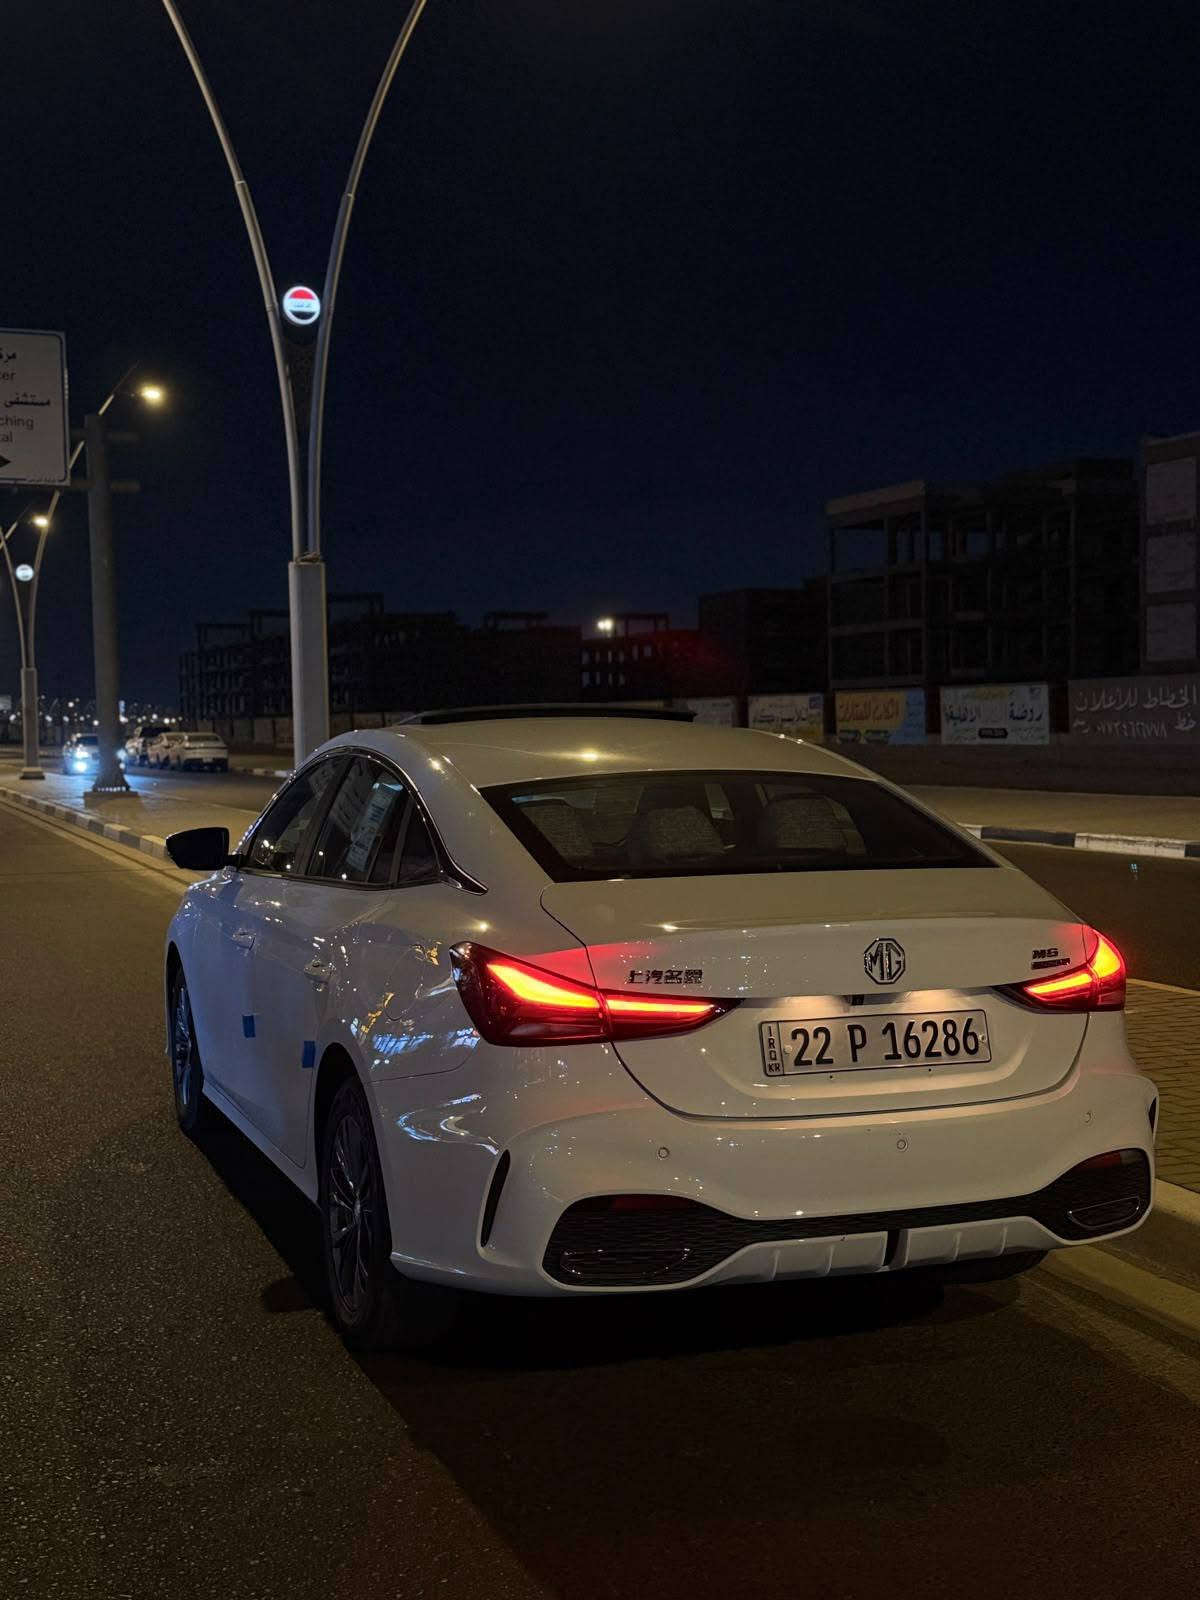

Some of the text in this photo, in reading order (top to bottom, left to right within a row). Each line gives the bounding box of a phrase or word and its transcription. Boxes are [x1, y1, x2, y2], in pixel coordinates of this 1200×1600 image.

[866, 940, 903, 982] MG
[791, 1017, 979, 1066] 22 P 16286
[768, 1062, 781, 1072] KR
